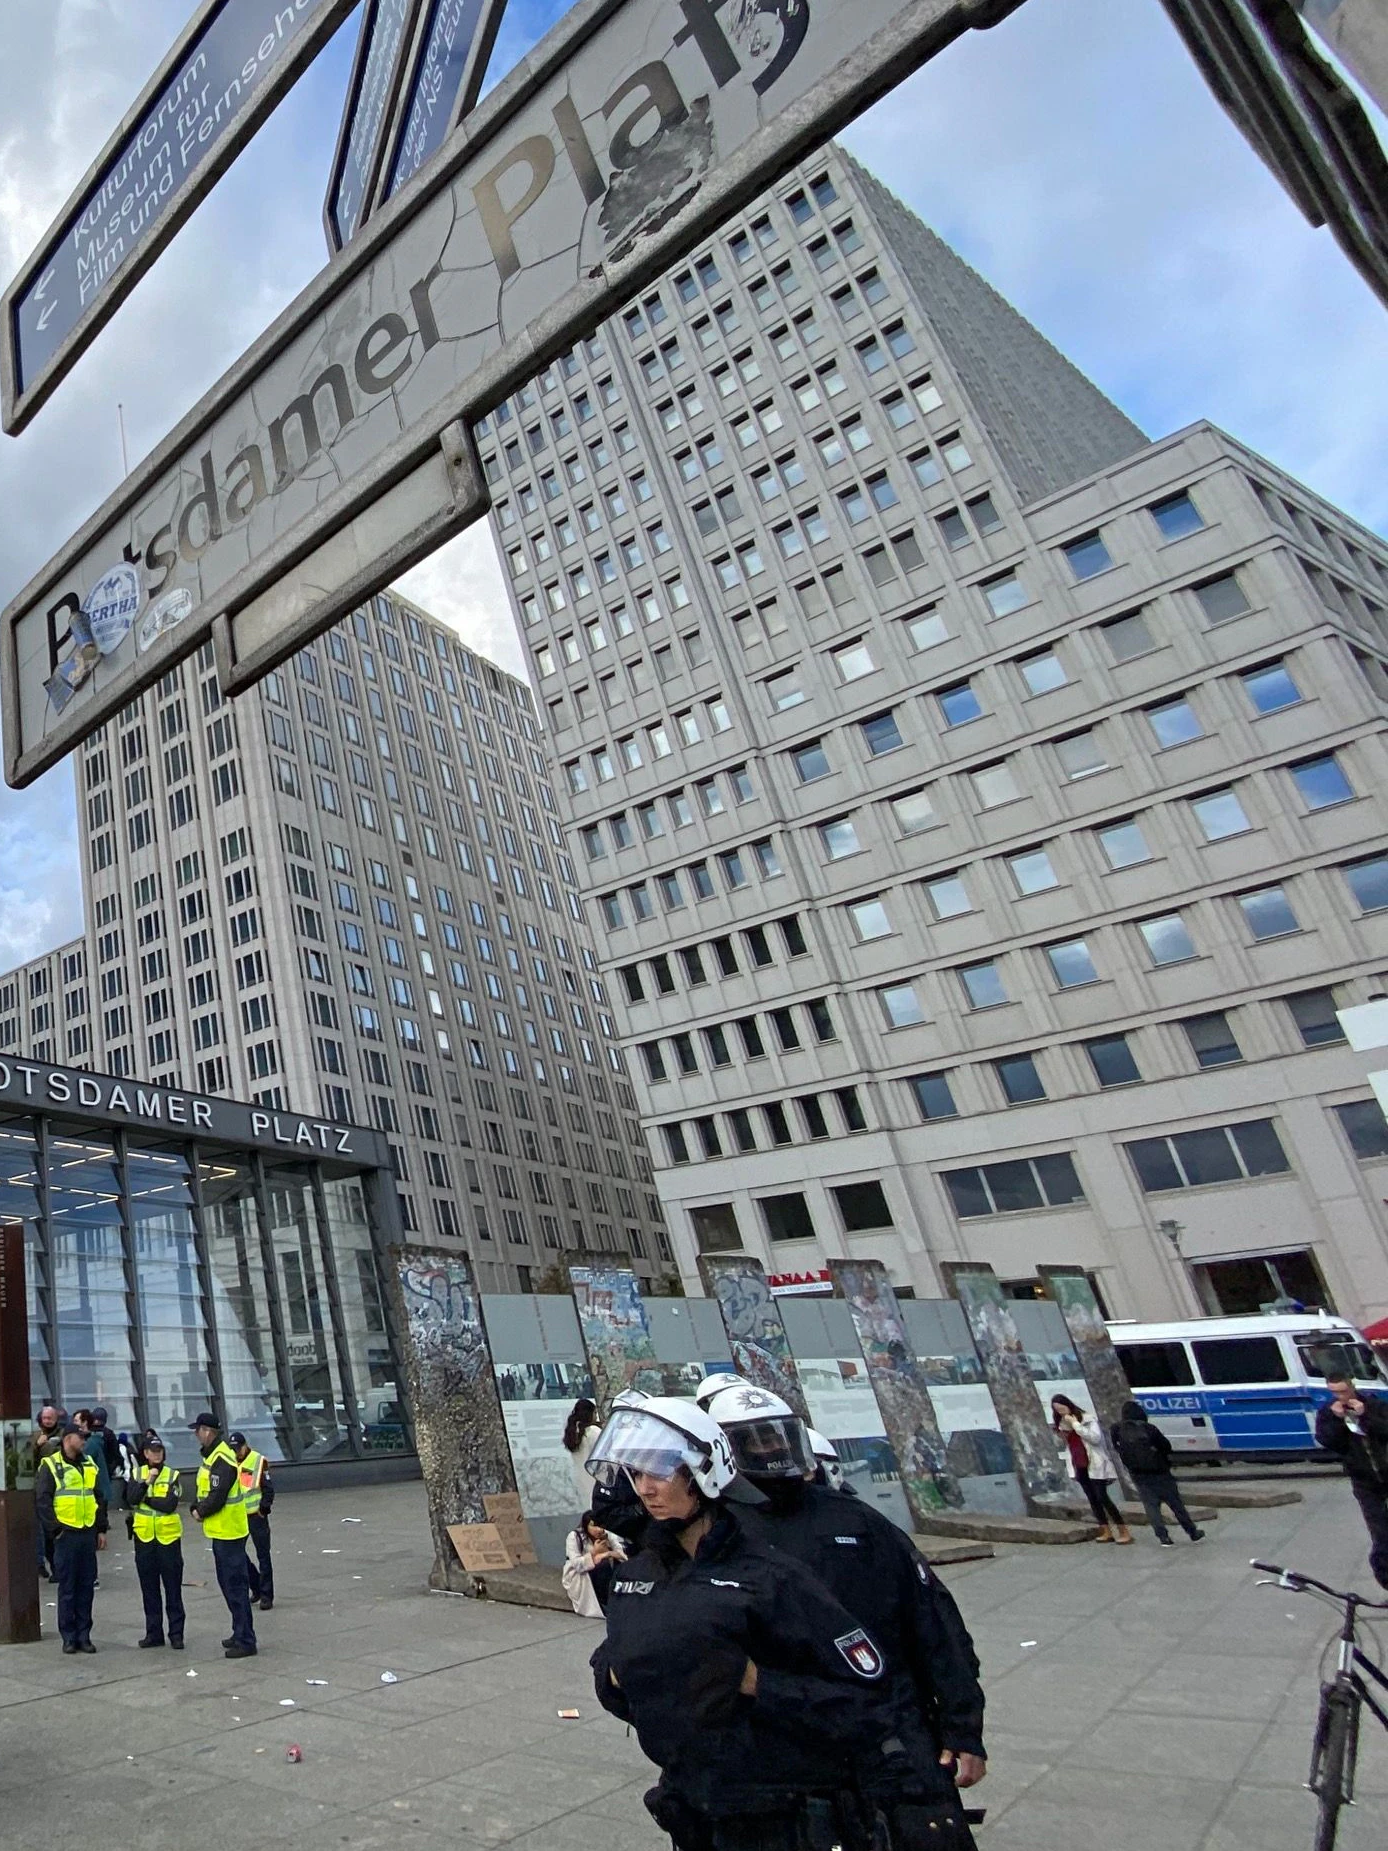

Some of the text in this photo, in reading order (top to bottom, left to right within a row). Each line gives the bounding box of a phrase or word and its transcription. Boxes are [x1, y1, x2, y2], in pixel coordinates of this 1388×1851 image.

[73, 52, 207, 249] Kulturforum
[405, 98, 422, 157] und
[421, 0, 451, 97] Inform
[413, 117, 428, 168] der
[427, 65, 443, 117] NS
[76, 82, 211, 280] Museum für
[79, 242, 125, 306] Film
[129, 165, 174, 236] und
[251, 1112, 354, 1154] PLATZ
